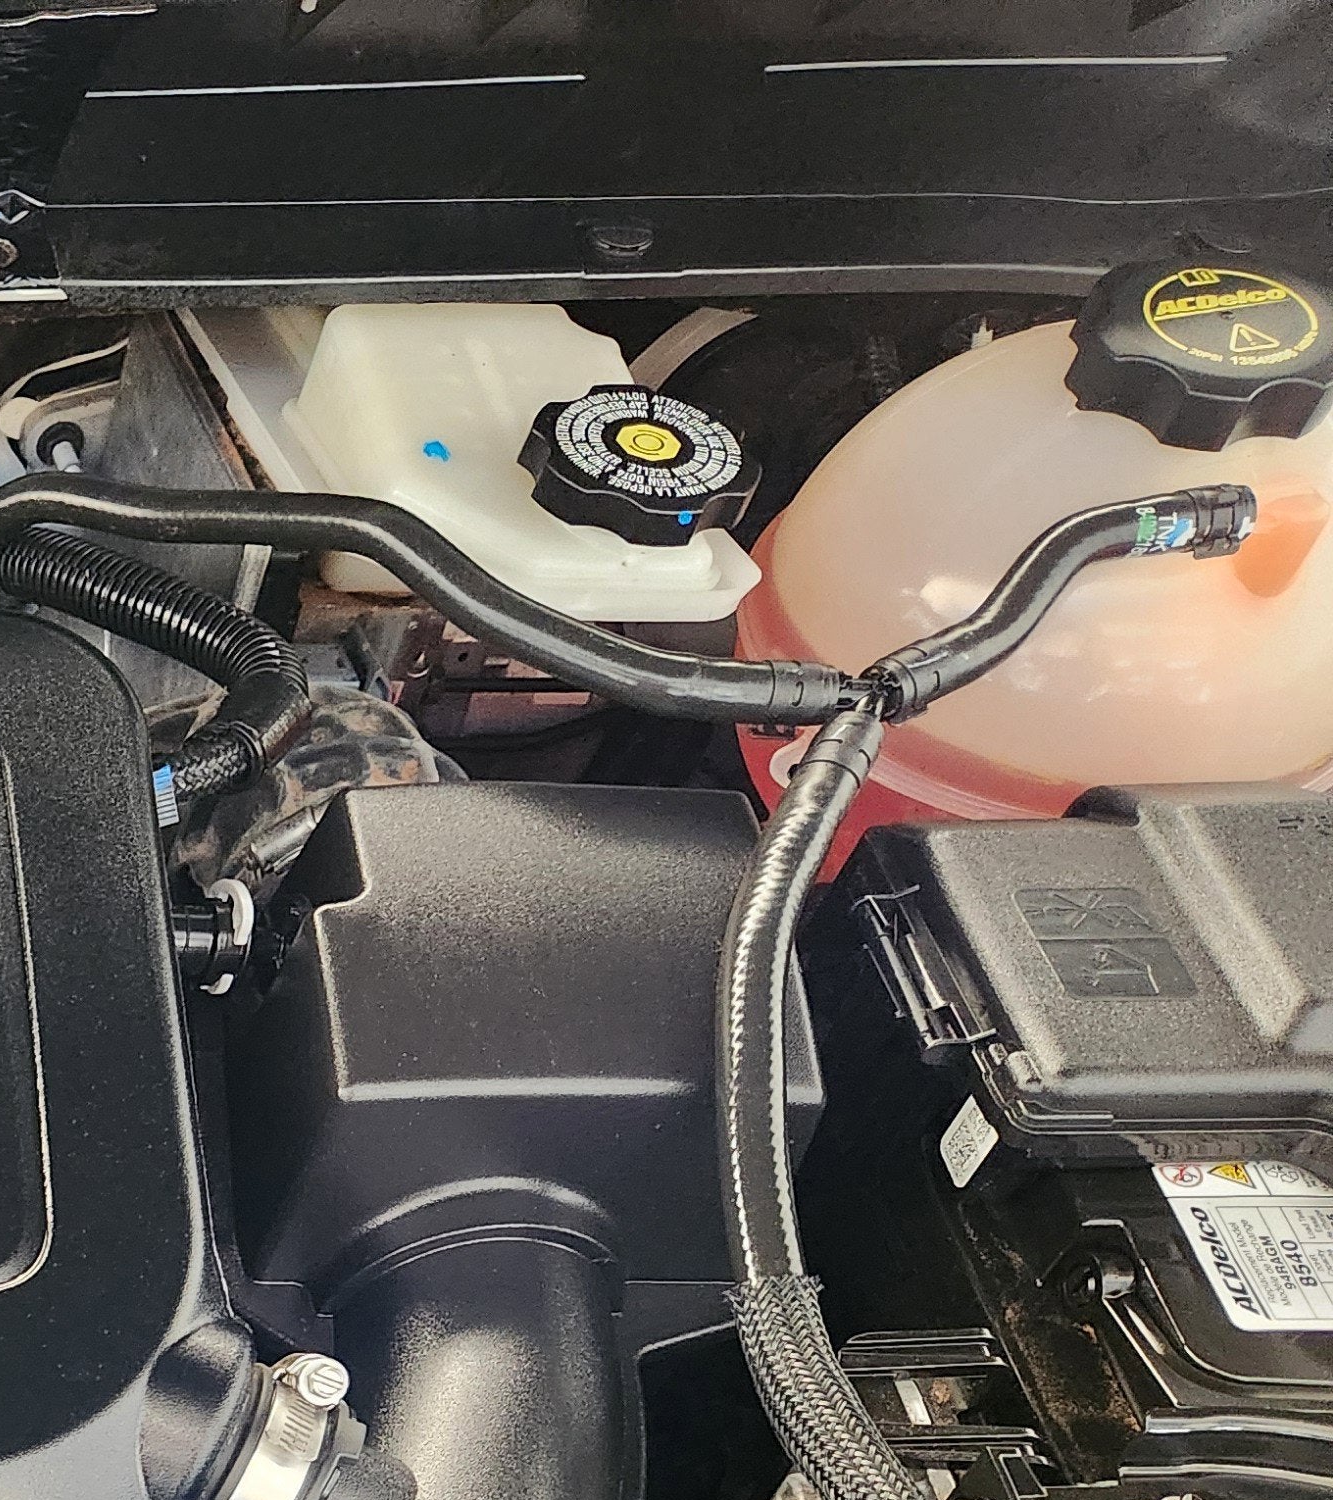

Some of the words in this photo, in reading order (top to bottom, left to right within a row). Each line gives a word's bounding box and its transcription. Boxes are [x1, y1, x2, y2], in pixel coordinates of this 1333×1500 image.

[1155, 288, 1286, 315] ACDelco
[626, 401, 648, 410] CAP
[585, 455, 616, 473] ONLY
[726, 454, 741, 466] LE
[647, 476, 682, 487] FREIN
[678, 474, 700, 485] DE
[655, 486, 674, 496] LA
[675, 483, 710, 497] AVANT
[1149, 512, 1178, 551] TNK
[1190, 1206, 1261, 1316] ACDelco
[1258, 1235, 1297, 1290] 94RAGM
[1280, 1240, 1318, 1287] 8540
